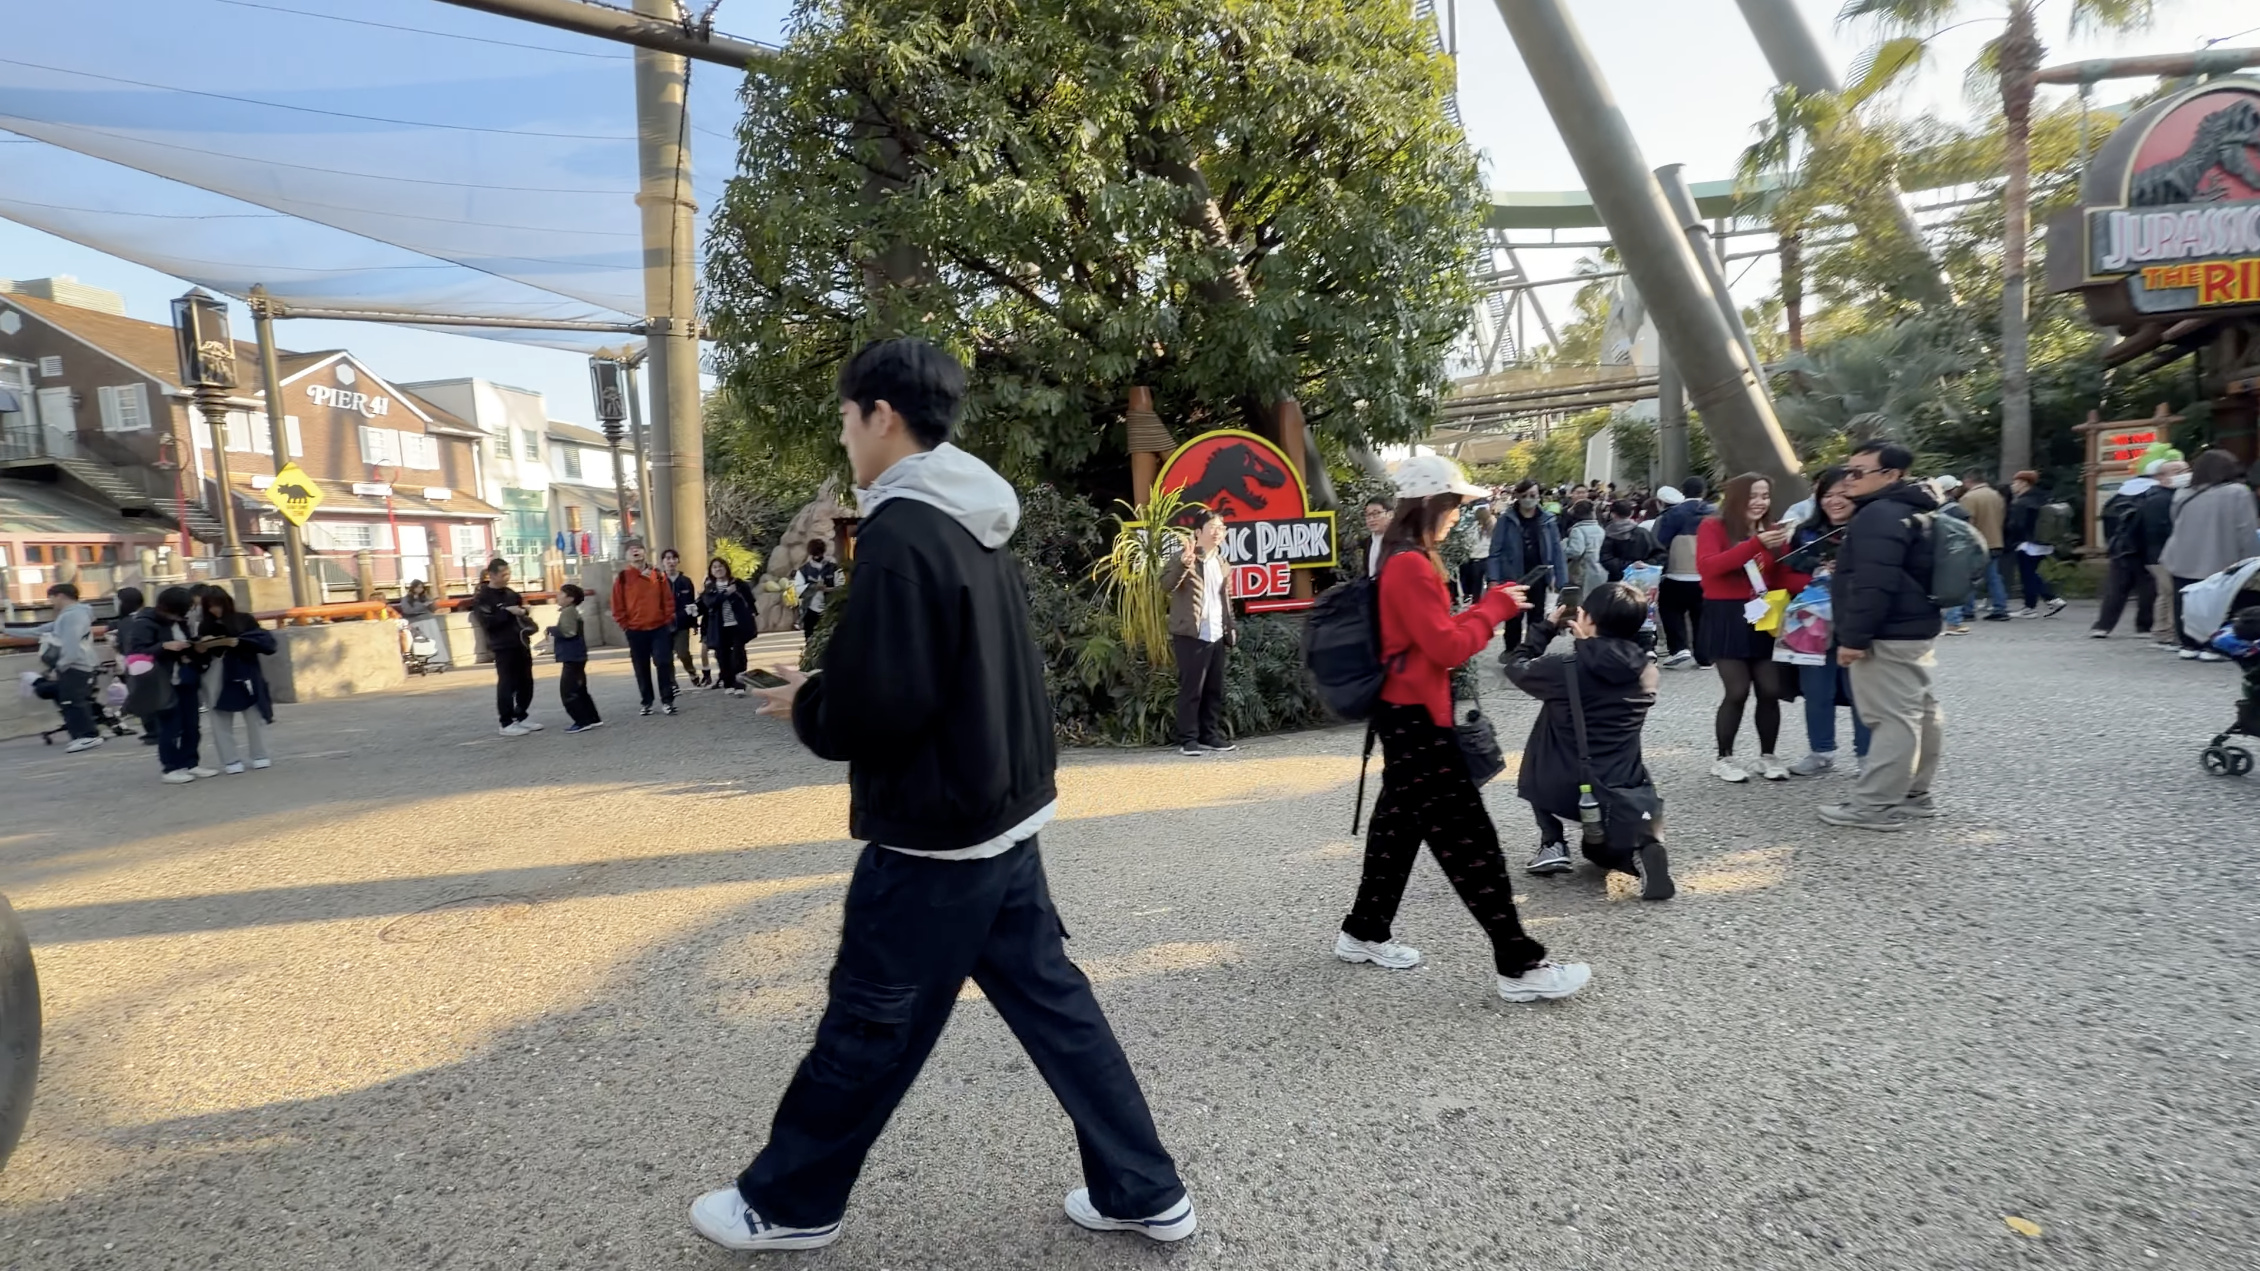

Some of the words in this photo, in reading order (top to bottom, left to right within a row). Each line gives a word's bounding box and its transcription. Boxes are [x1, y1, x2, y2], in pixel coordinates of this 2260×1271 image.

[2142, 264, 2201, 290] THE
[2199, 258, 2260, 305] RI
[306, 384, 376, 418] PIER
[369, 395, 389, 415] 41
[1255, 521, 1330, 564] PARK
[1229, 561, 1291, 599] IDE
